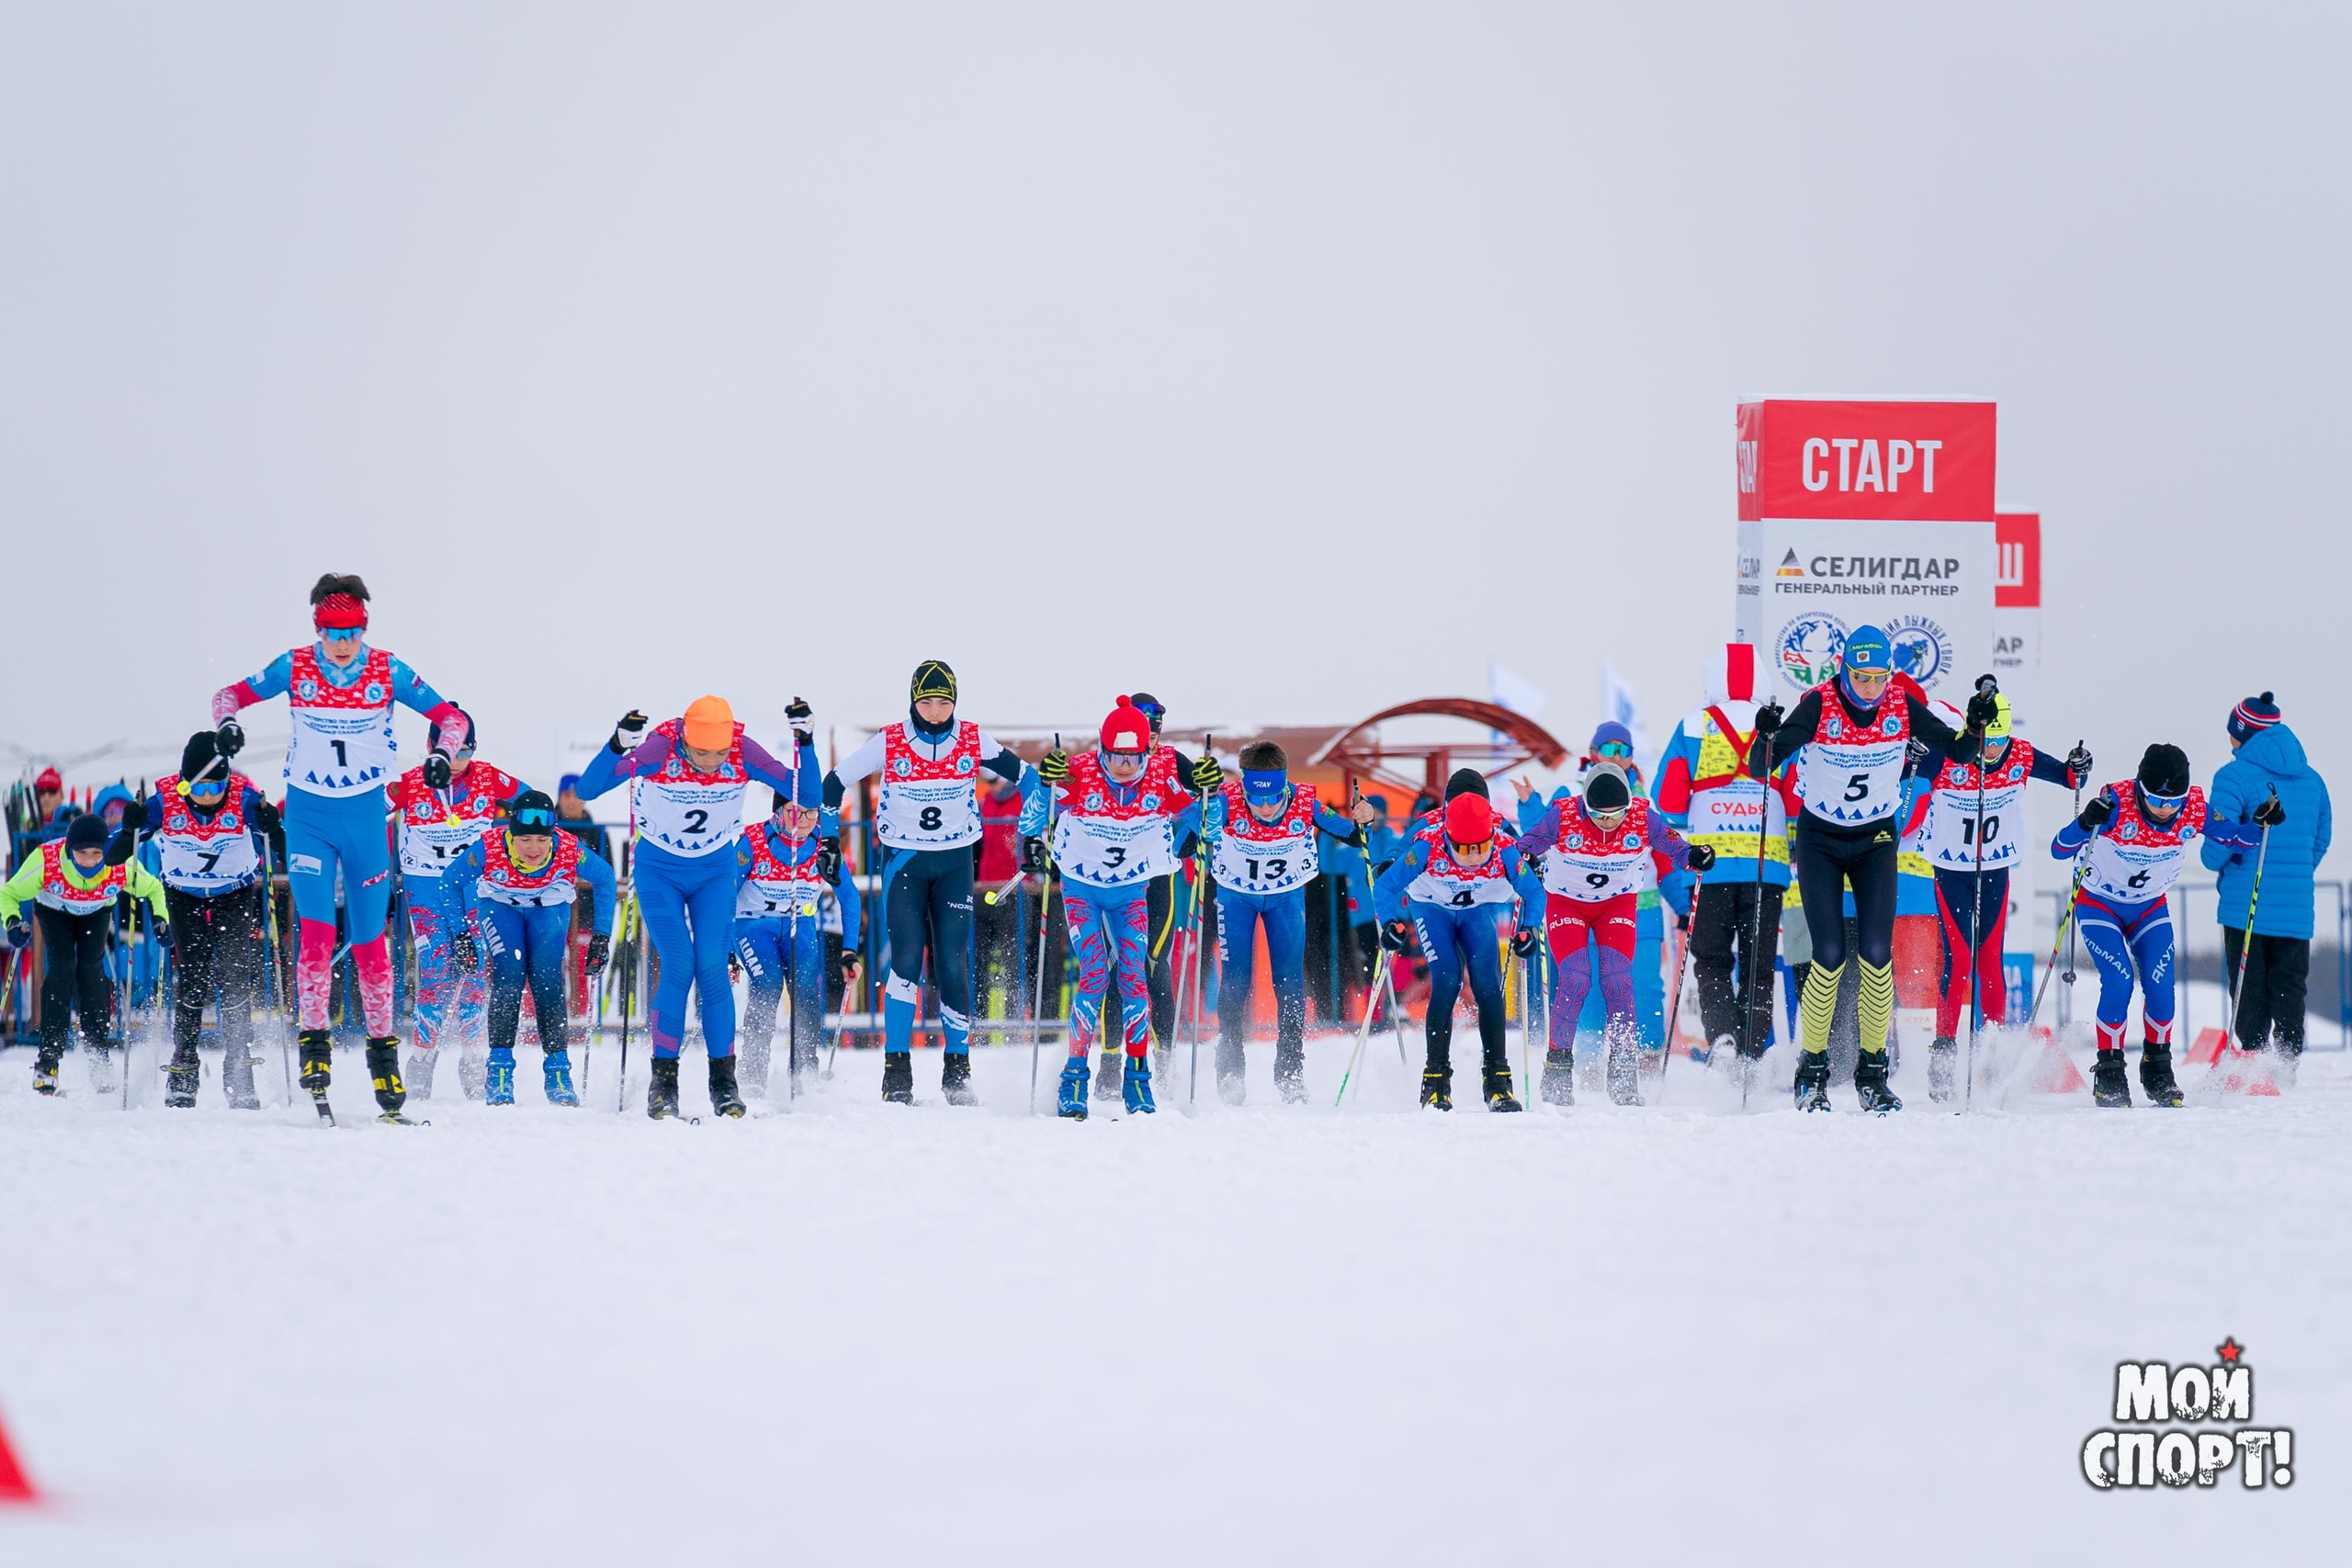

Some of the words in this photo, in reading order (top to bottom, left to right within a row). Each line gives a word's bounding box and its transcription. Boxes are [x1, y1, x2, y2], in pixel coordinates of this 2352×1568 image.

[1802, 438, 1942, 493] СТАРТ
[1810, 556, 1960, 581] СЕЛИГДАР
[1775, 581, 1886, 596] ГЕНЕРАЛЬНЫЙ
[1891, 585, 1960, 597] ПАРТНЕР
[1905, 615, 1947, 641] ЛЫЖНЫХ
[1938, 642, 1953, 676] ГОНОК
[330, 739, 347, 767] 1
[1844, 773, 1870, 802] 5
[639, 817, 648, 828] 2
[681, 809, 708, 834] 2
[879, 824, 888, 834] 8
[920, 807, 943, 831] 8
[1962, 815, 1999, 845] 10
[197, 852, 220, 873] 7
[1102, 846, 1126, 869] 3
[1245, 858, 1287, 881] 13
[1586, 873, 1610, 889] 9
[1449, 890, 1475, 906] 4
[481, 917, 505, 956] ALDAN
[1550, 917, 1586, 931] RUSSIA
[1416, 917, 1438, 963] ALDAN
[739, 937, 764, 977] ALDAN
[2152, 941, 2176, 984] ЯКУТ
